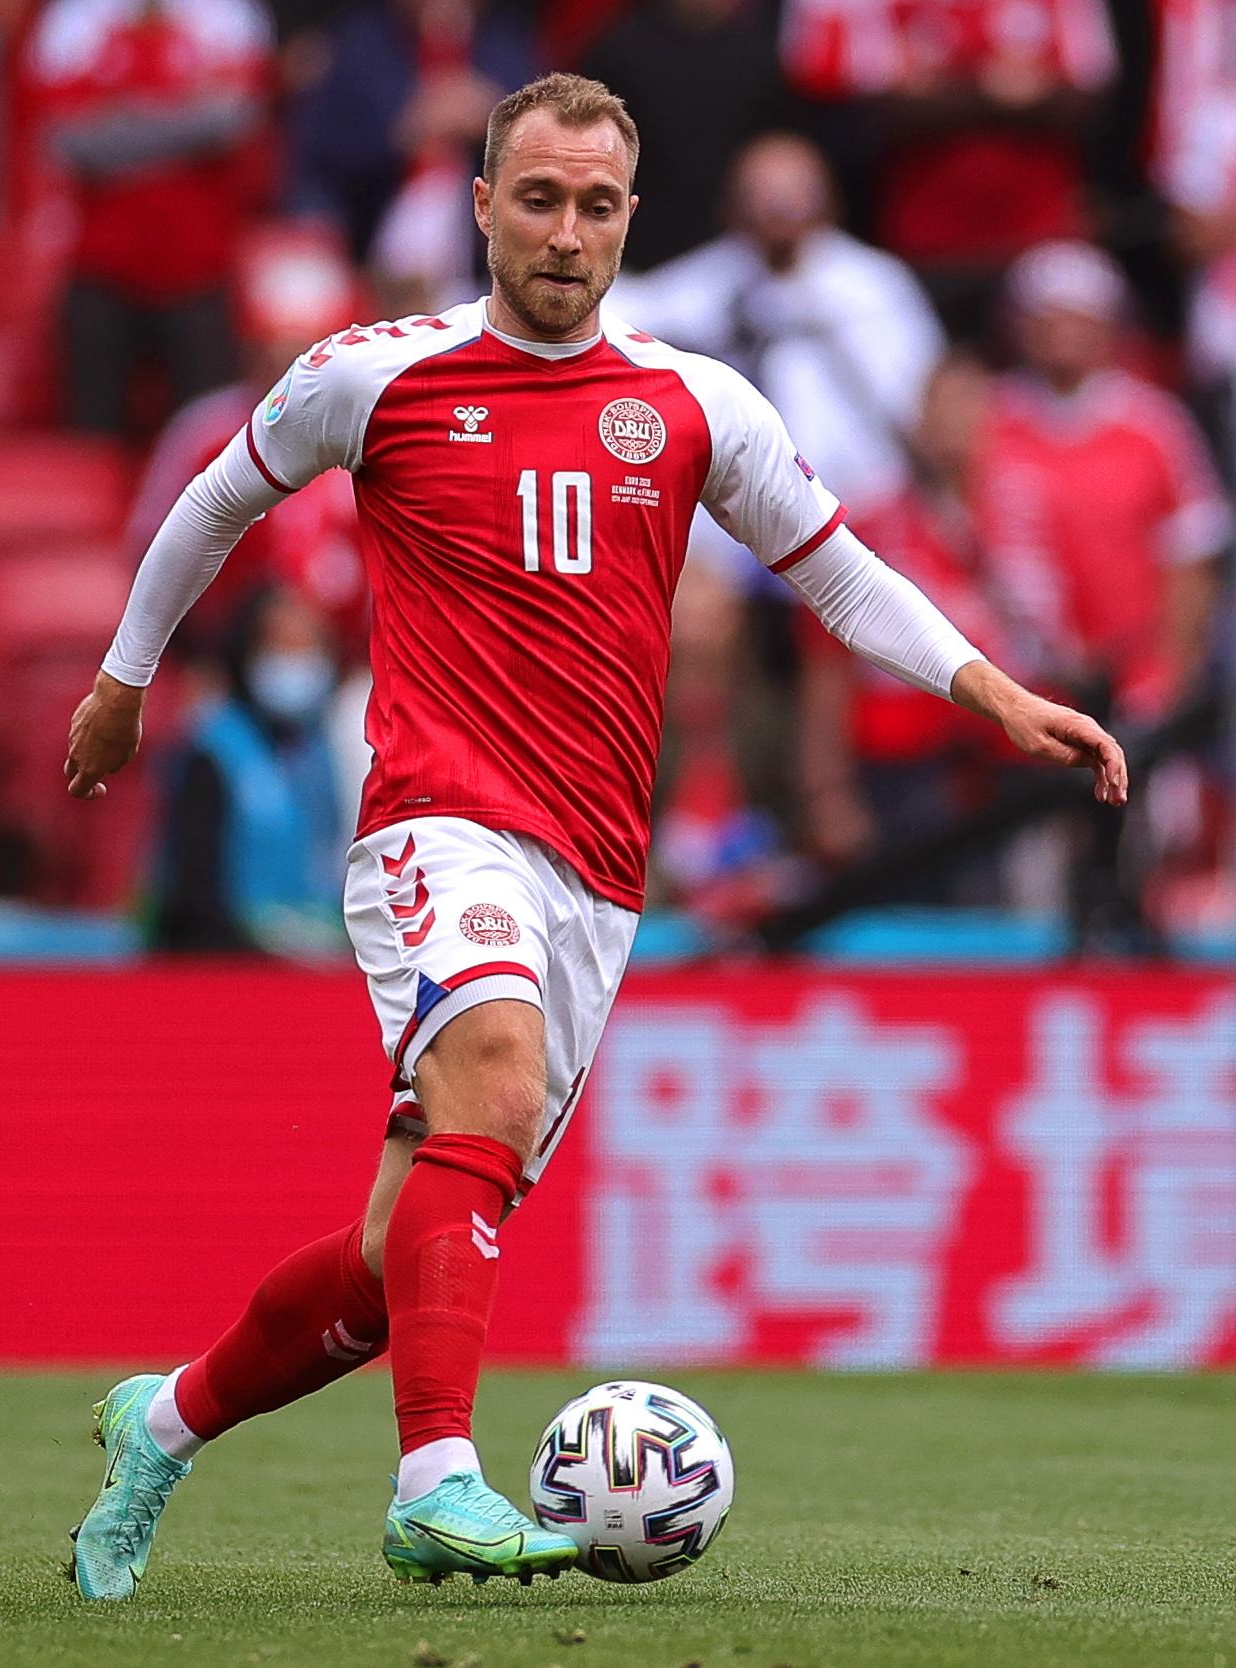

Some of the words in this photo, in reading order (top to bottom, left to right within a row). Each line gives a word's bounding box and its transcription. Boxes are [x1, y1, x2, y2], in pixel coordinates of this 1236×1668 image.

[449, 430, 493, 443] hummel
[613, 419, 651, 440] DBU
[516, 469, 592, 574] 10
[470, 916, 511, 933] DBU
